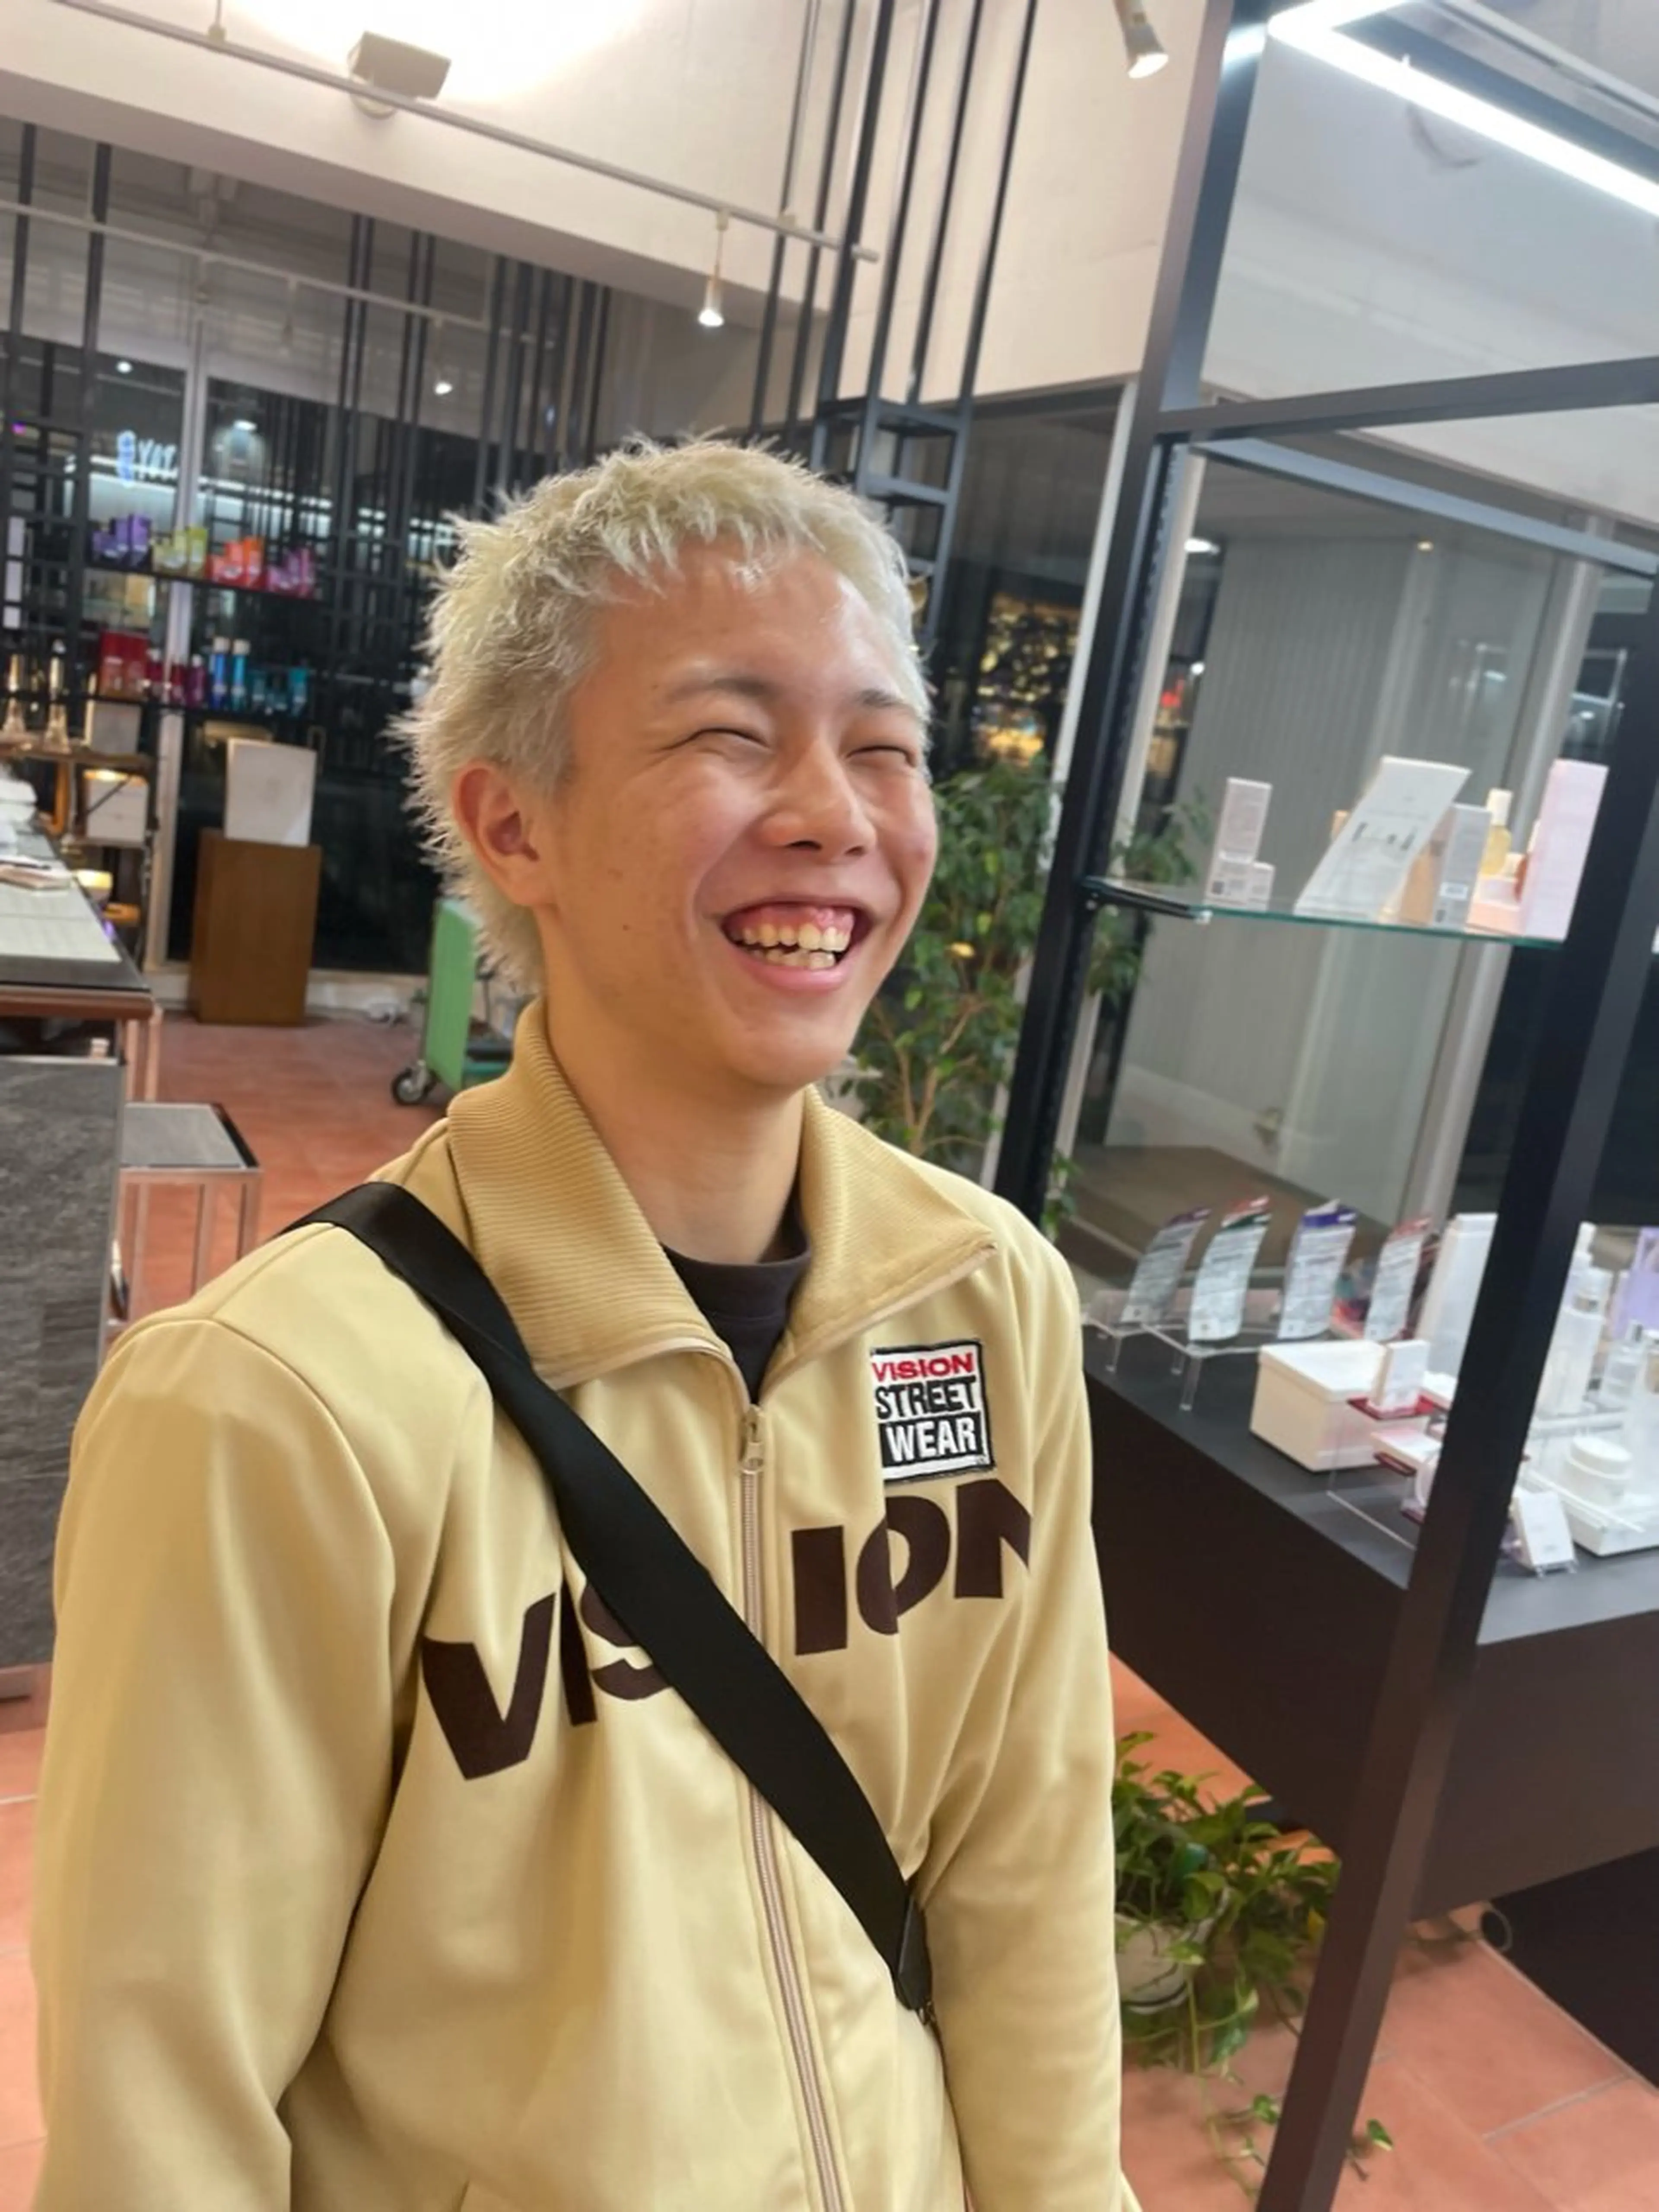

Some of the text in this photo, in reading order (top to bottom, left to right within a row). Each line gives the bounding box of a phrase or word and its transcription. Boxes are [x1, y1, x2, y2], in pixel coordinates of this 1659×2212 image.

[872, 1352, 974, 1382] VISION
[875, 1375, 976, 1420] STREET
[886, 1417, 977, 1463] WEAR
